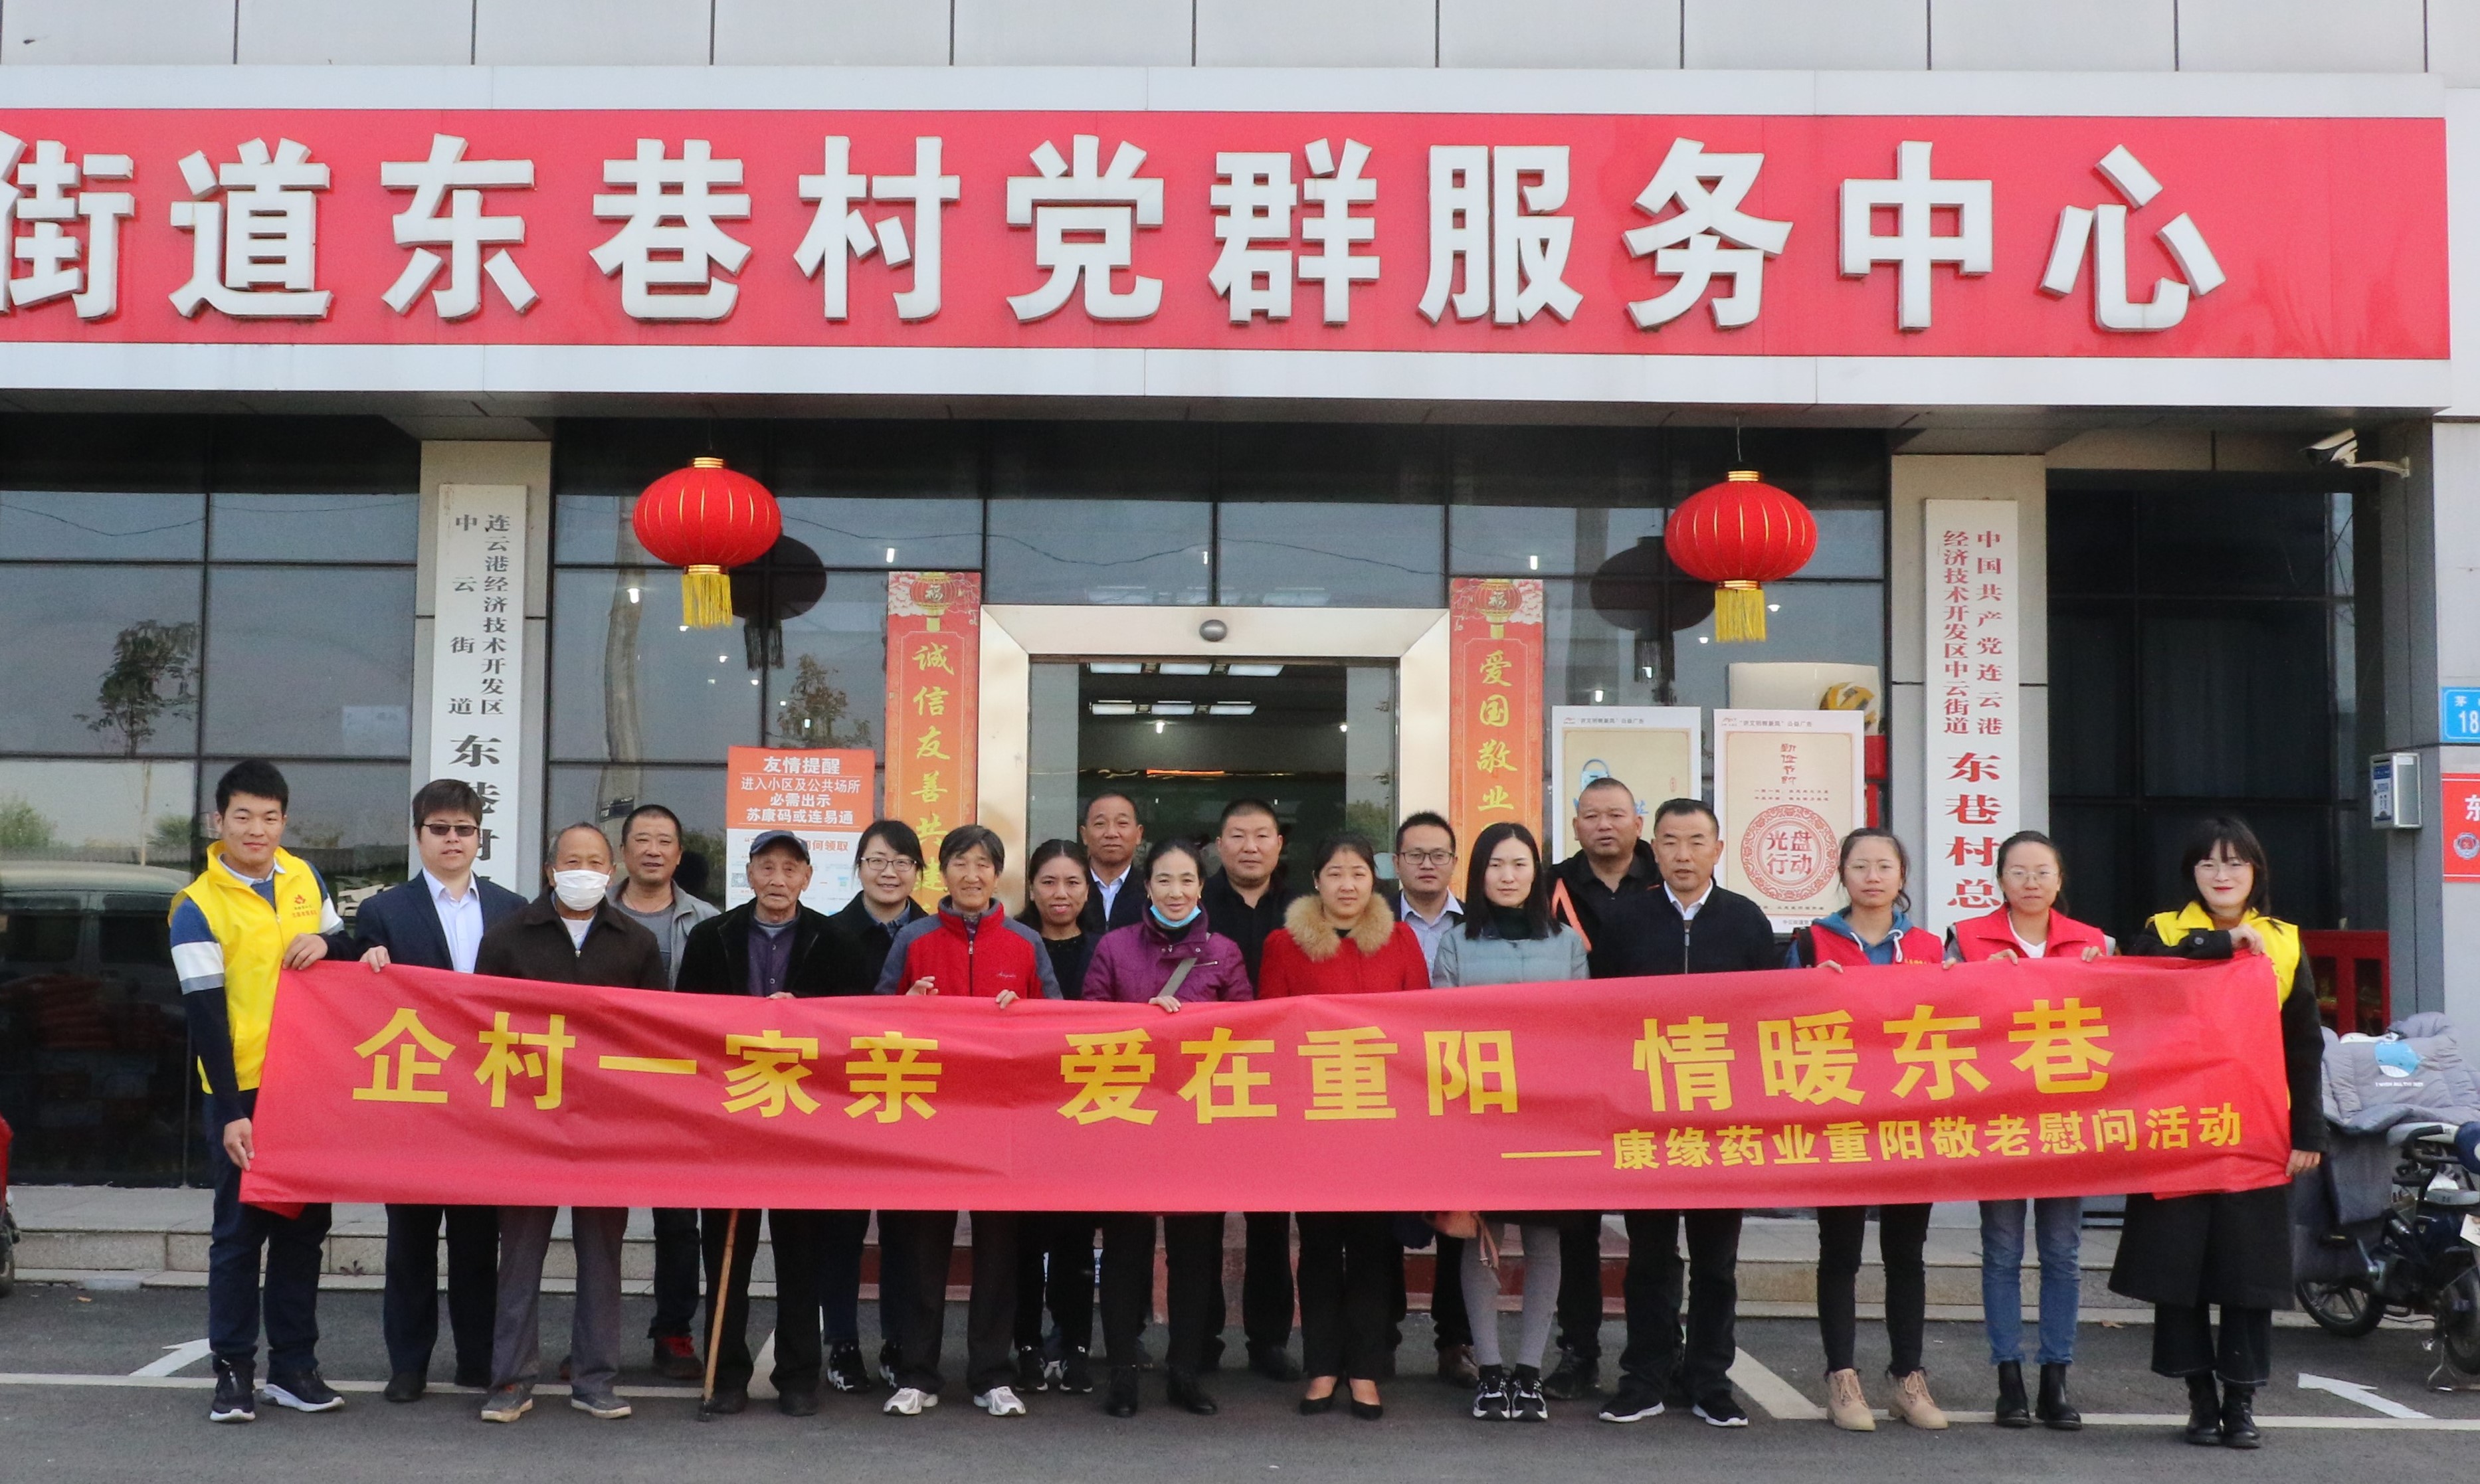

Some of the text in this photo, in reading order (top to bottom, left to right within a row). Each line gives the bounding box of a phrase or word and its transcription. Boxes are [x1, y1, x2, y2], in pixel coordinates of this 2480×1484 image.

[0, 130, 2226, 333] 街道东巷村党群服务中心
[447, 513, 478, 715] 中云街道
[480, 513, 511, 716] 连云港经济技术开发区
[1943, 529, 1970, 735] 经济技术开发区中云街道
[1976, 529, 2003, 736] 中国共产党连云港
[741, 777, 861, 794] 进入小区及公共场所
[745, 808, 854, 825] 苏康码或连易通
[763, 756, 840, 775] 友情提醒
[769, 793, 832, 808] 必需出示
[911, 642, 954, 911] 诚信友善共建
[1476, 649, 1517, 830] 爱国敬业
[1766, 831, 1813, 852] 光盘
[1766, 853, 1813, 876] 行动
[353, 998, 2114, 1125] 企村一家亲 爱在重阳 情暖东巷
